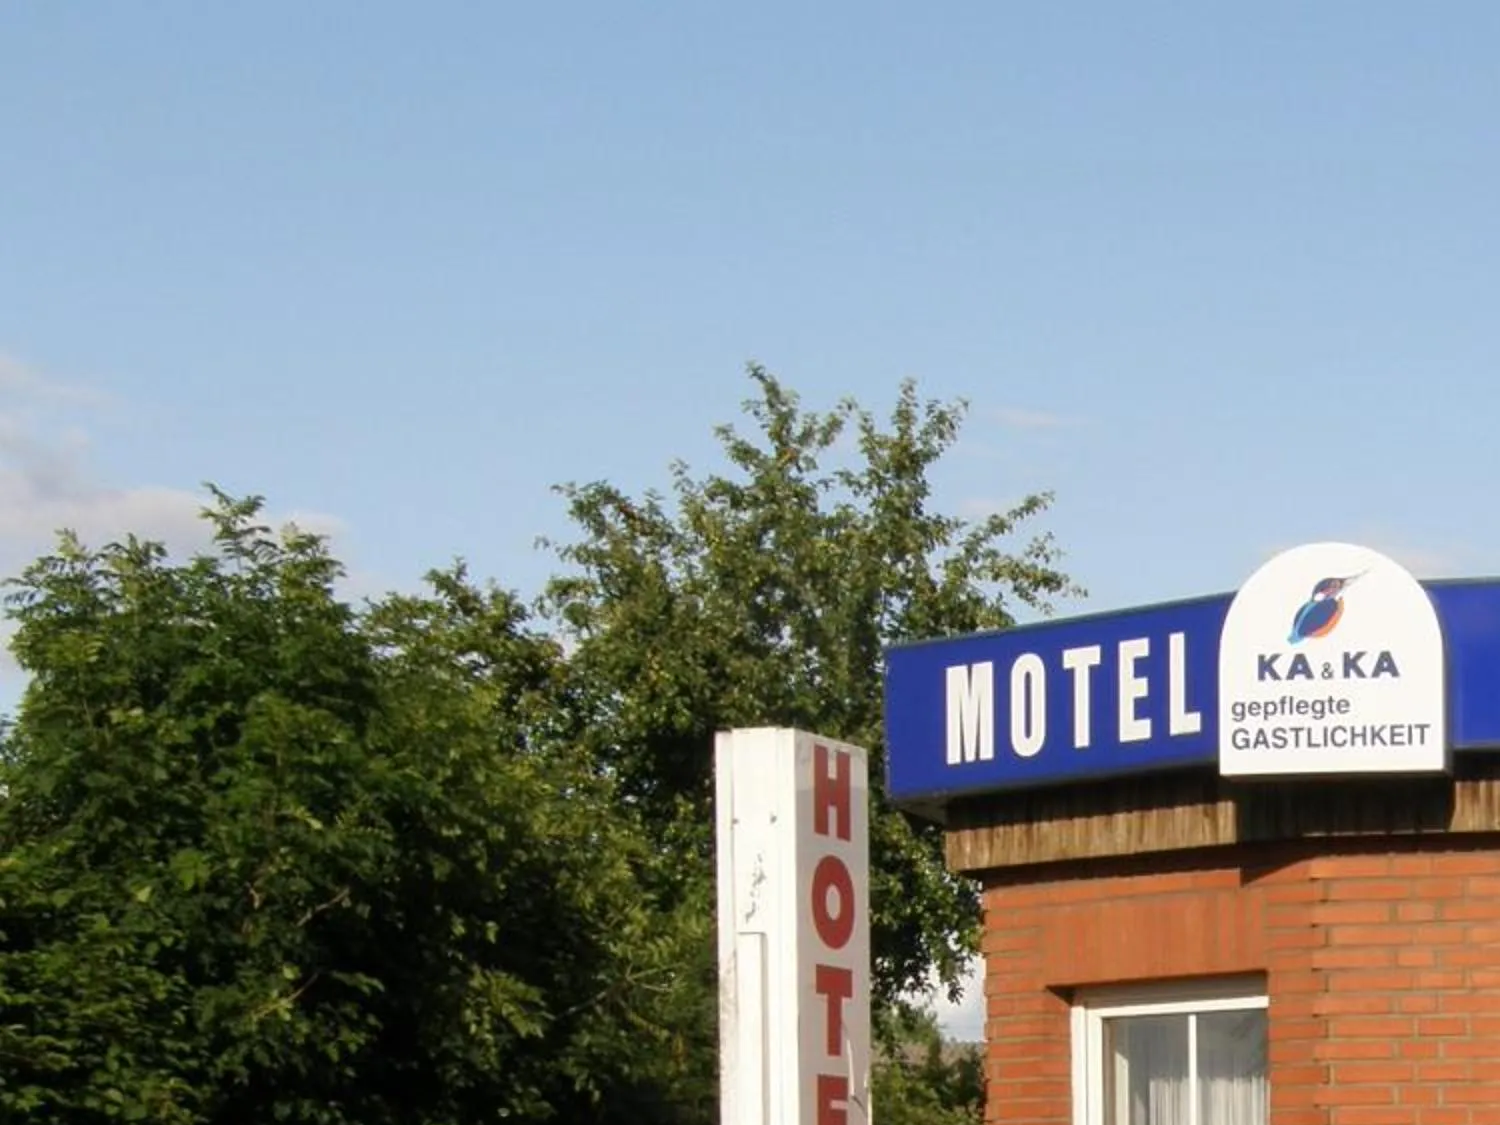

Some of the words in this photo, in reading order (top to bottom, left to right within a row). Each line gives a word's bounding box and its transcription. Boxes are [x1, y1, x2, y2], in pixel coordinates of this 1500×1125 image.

[946, 631, 1201, 766] MOTEL
[1231, 696, 1351, 722] gepflegte
[1231, 724, 1431, 750] GASTLICHKEIT
